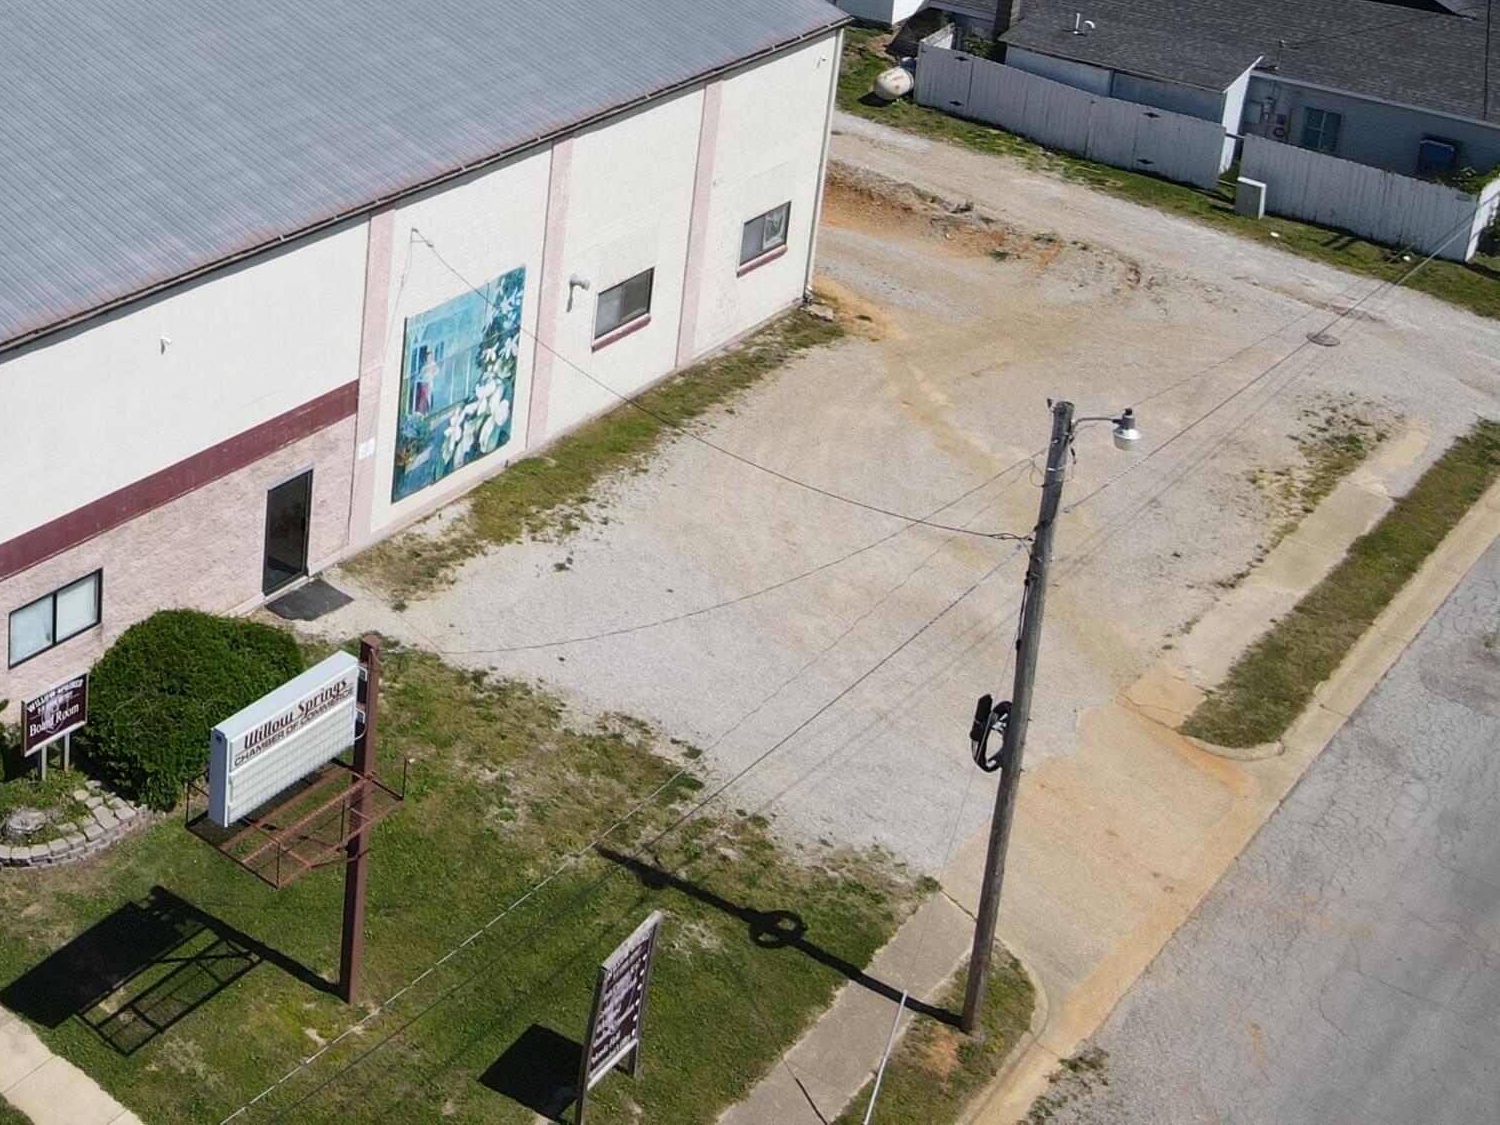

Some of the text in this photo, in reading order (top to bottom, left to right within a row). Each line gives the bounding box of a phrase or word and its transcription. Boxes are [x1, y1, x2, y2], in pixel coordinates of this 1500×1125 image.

[27, 690, 56, 713] WILLOW
[29, 704, 79, 737] Board Room
[234, 686, 354, 767] CHAMBER OF COMMERCE
[244, 678, 347, 750] Willow Springs
